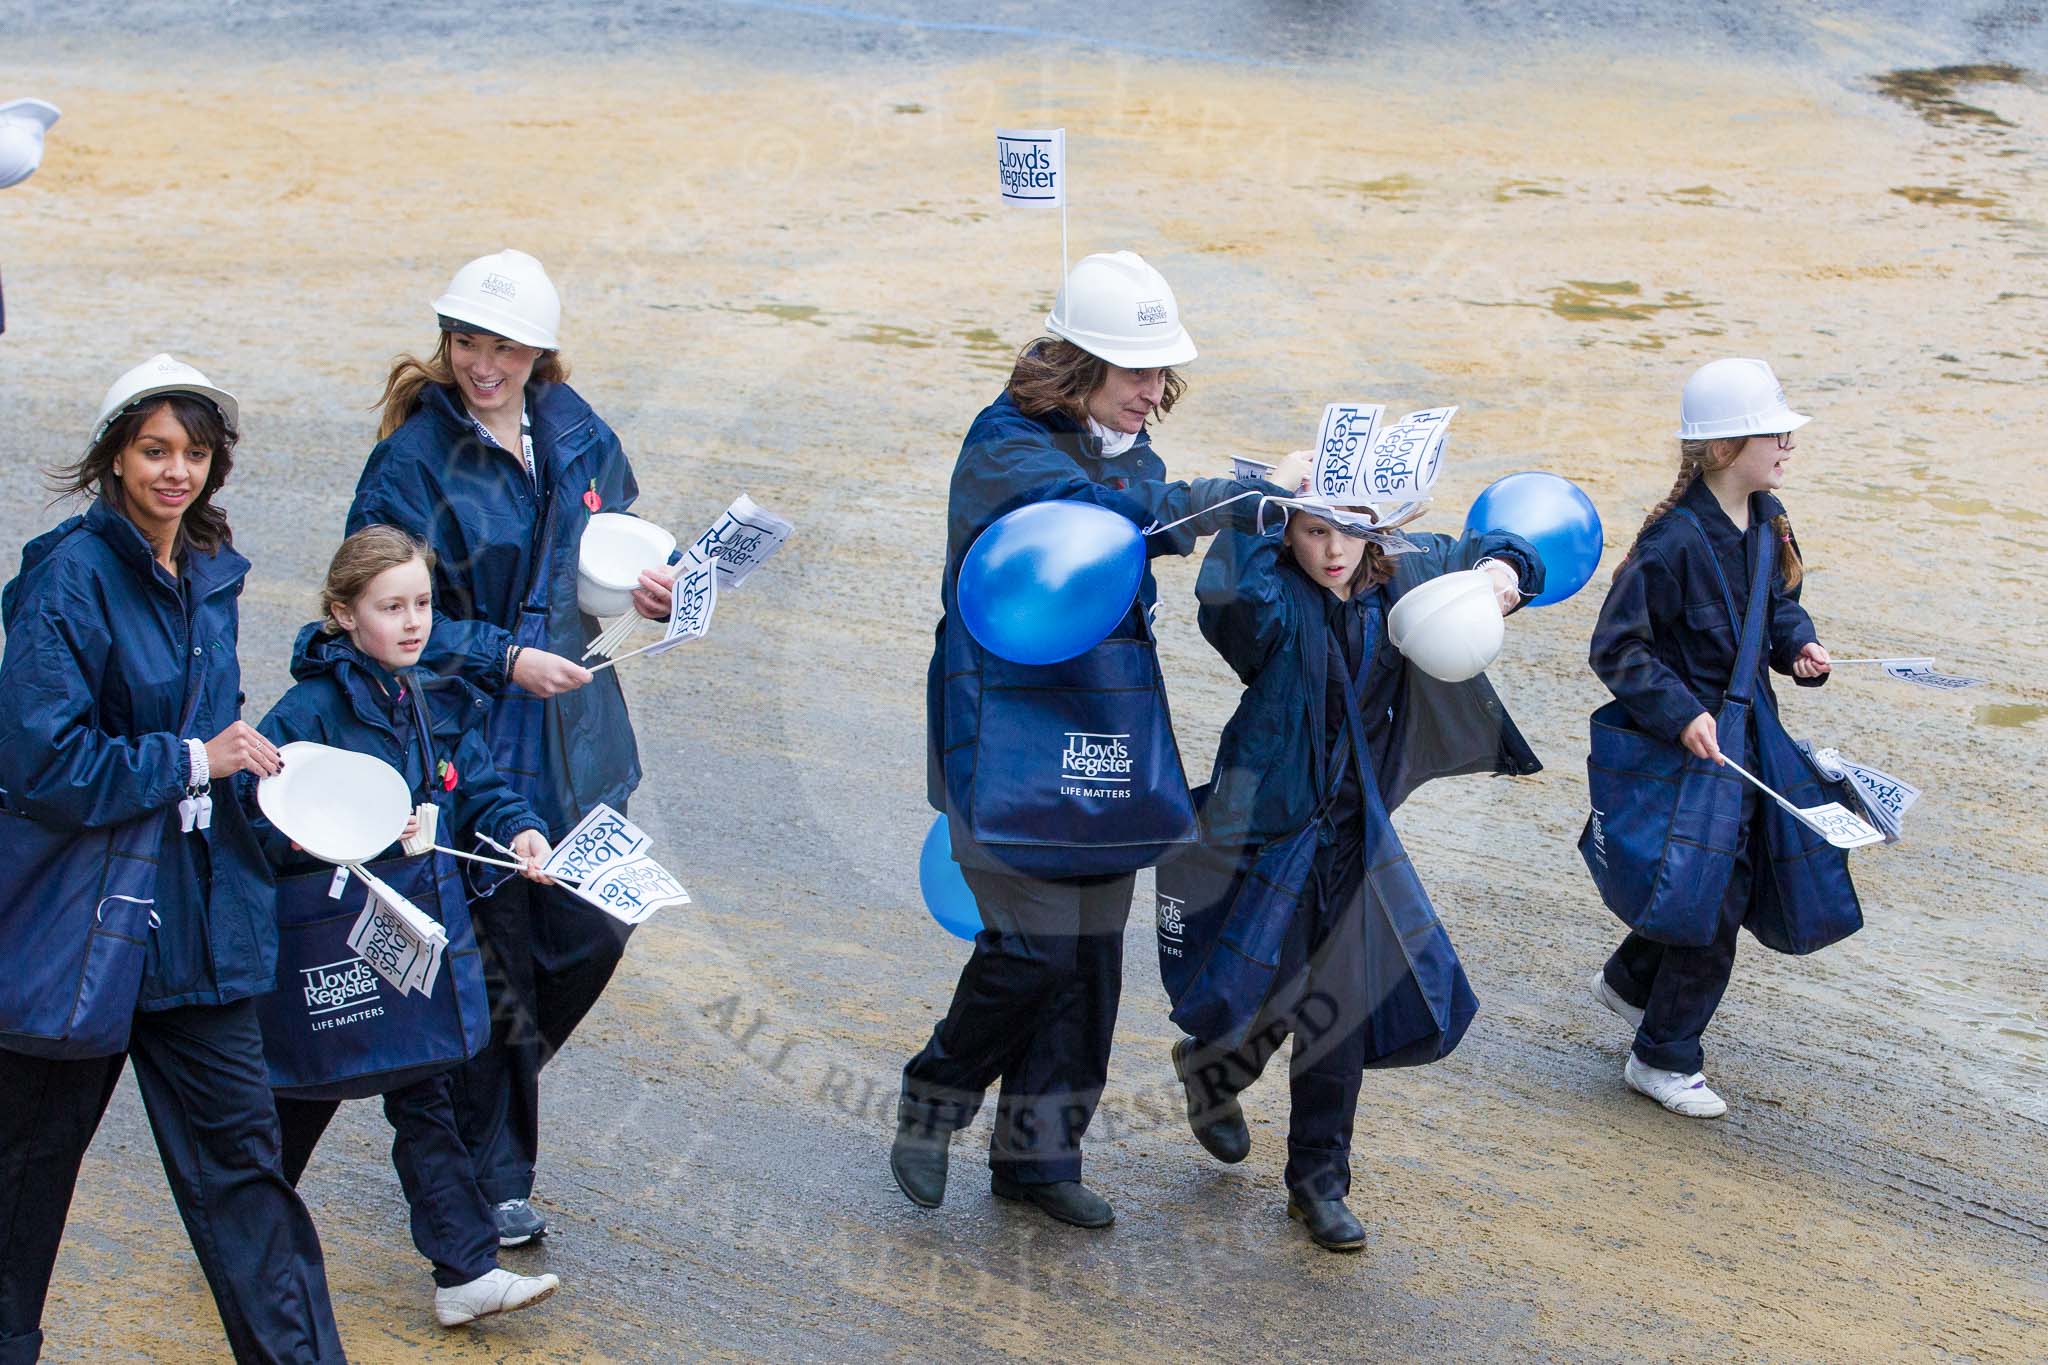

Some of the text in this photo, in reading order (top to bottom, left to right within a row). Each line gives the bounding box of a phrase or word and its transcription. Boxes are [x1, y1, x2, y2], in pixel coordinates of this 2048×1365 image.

[1000, 141, 1050, 175] Lloyd's
[1000, 160, 1056, 194] Register
[1324, 408, 1358, 498] Register
[1335, 416, 1370, 494] Lloyd's
[1374, 425, 1415, 496] Register
[1390, 428, 1431, 490] Lloyd's
[1062, 749, 1133, 777] Register
[1069, 736, 1129, 761] Lloyd's
[1060, 786, 1131, 799] LIFE MATTERS
[365, 904, 402, 965] Register
[304, 976, 379, 1007] Register
[306, 962, 372, 992] Lloyd's
[312, 1007, 385, 1032] LIFE MATTERS
